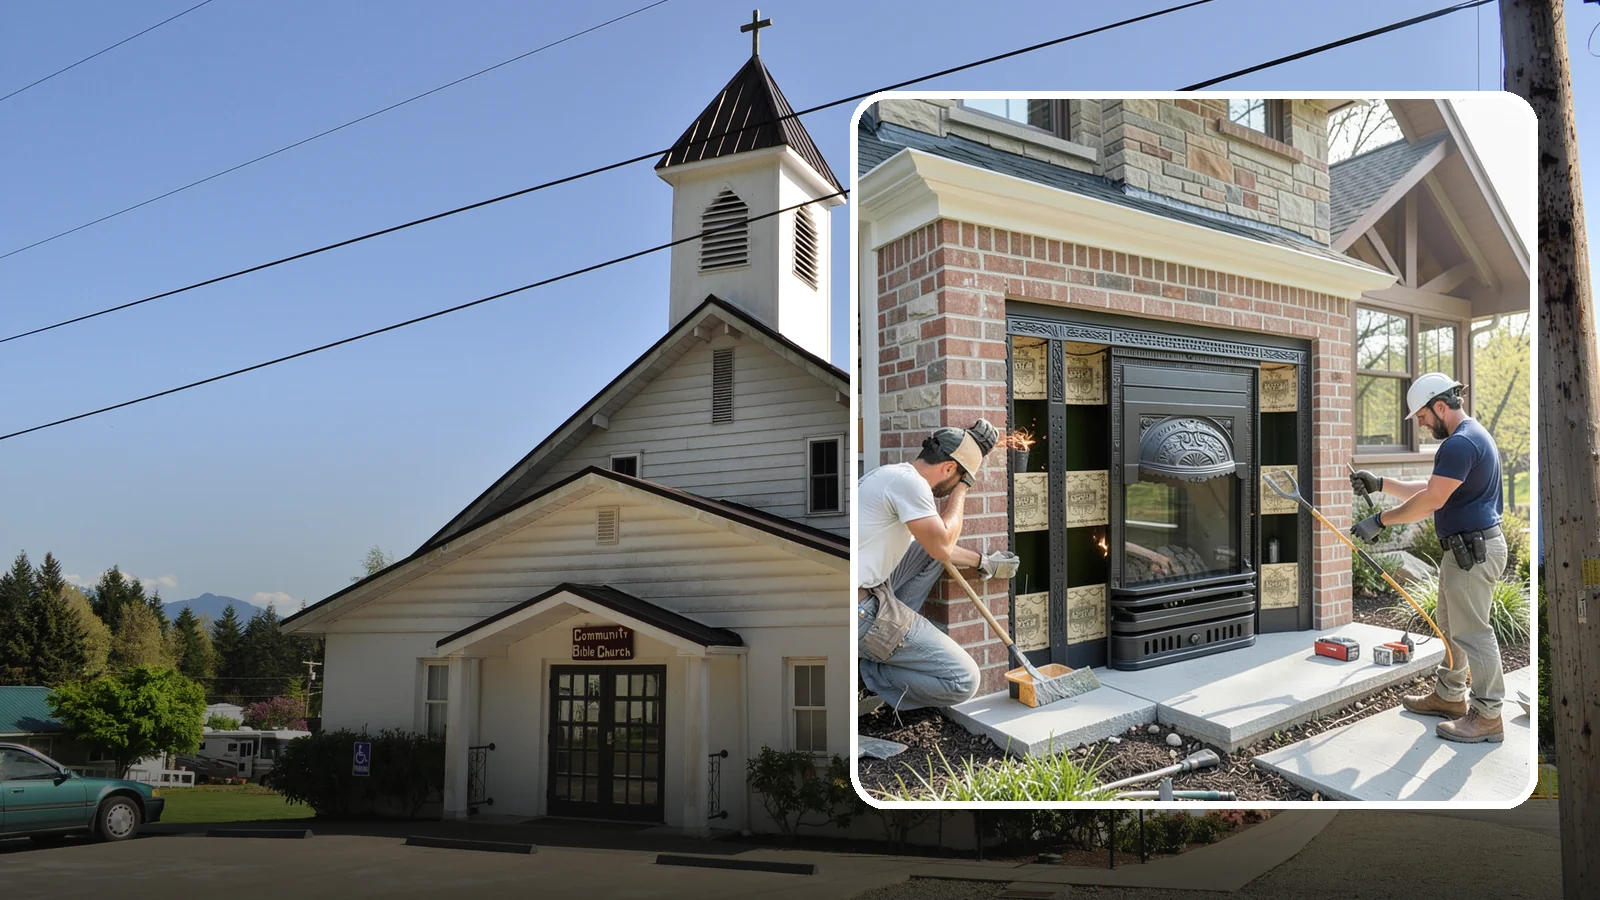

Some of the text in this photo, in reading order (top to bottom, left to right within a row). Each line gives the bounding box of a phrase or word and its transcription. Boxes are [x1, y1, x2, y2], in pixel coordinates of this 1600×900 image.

[574, 627, 628, 641] Community
[573, 645, 631, 658] Bible Church
